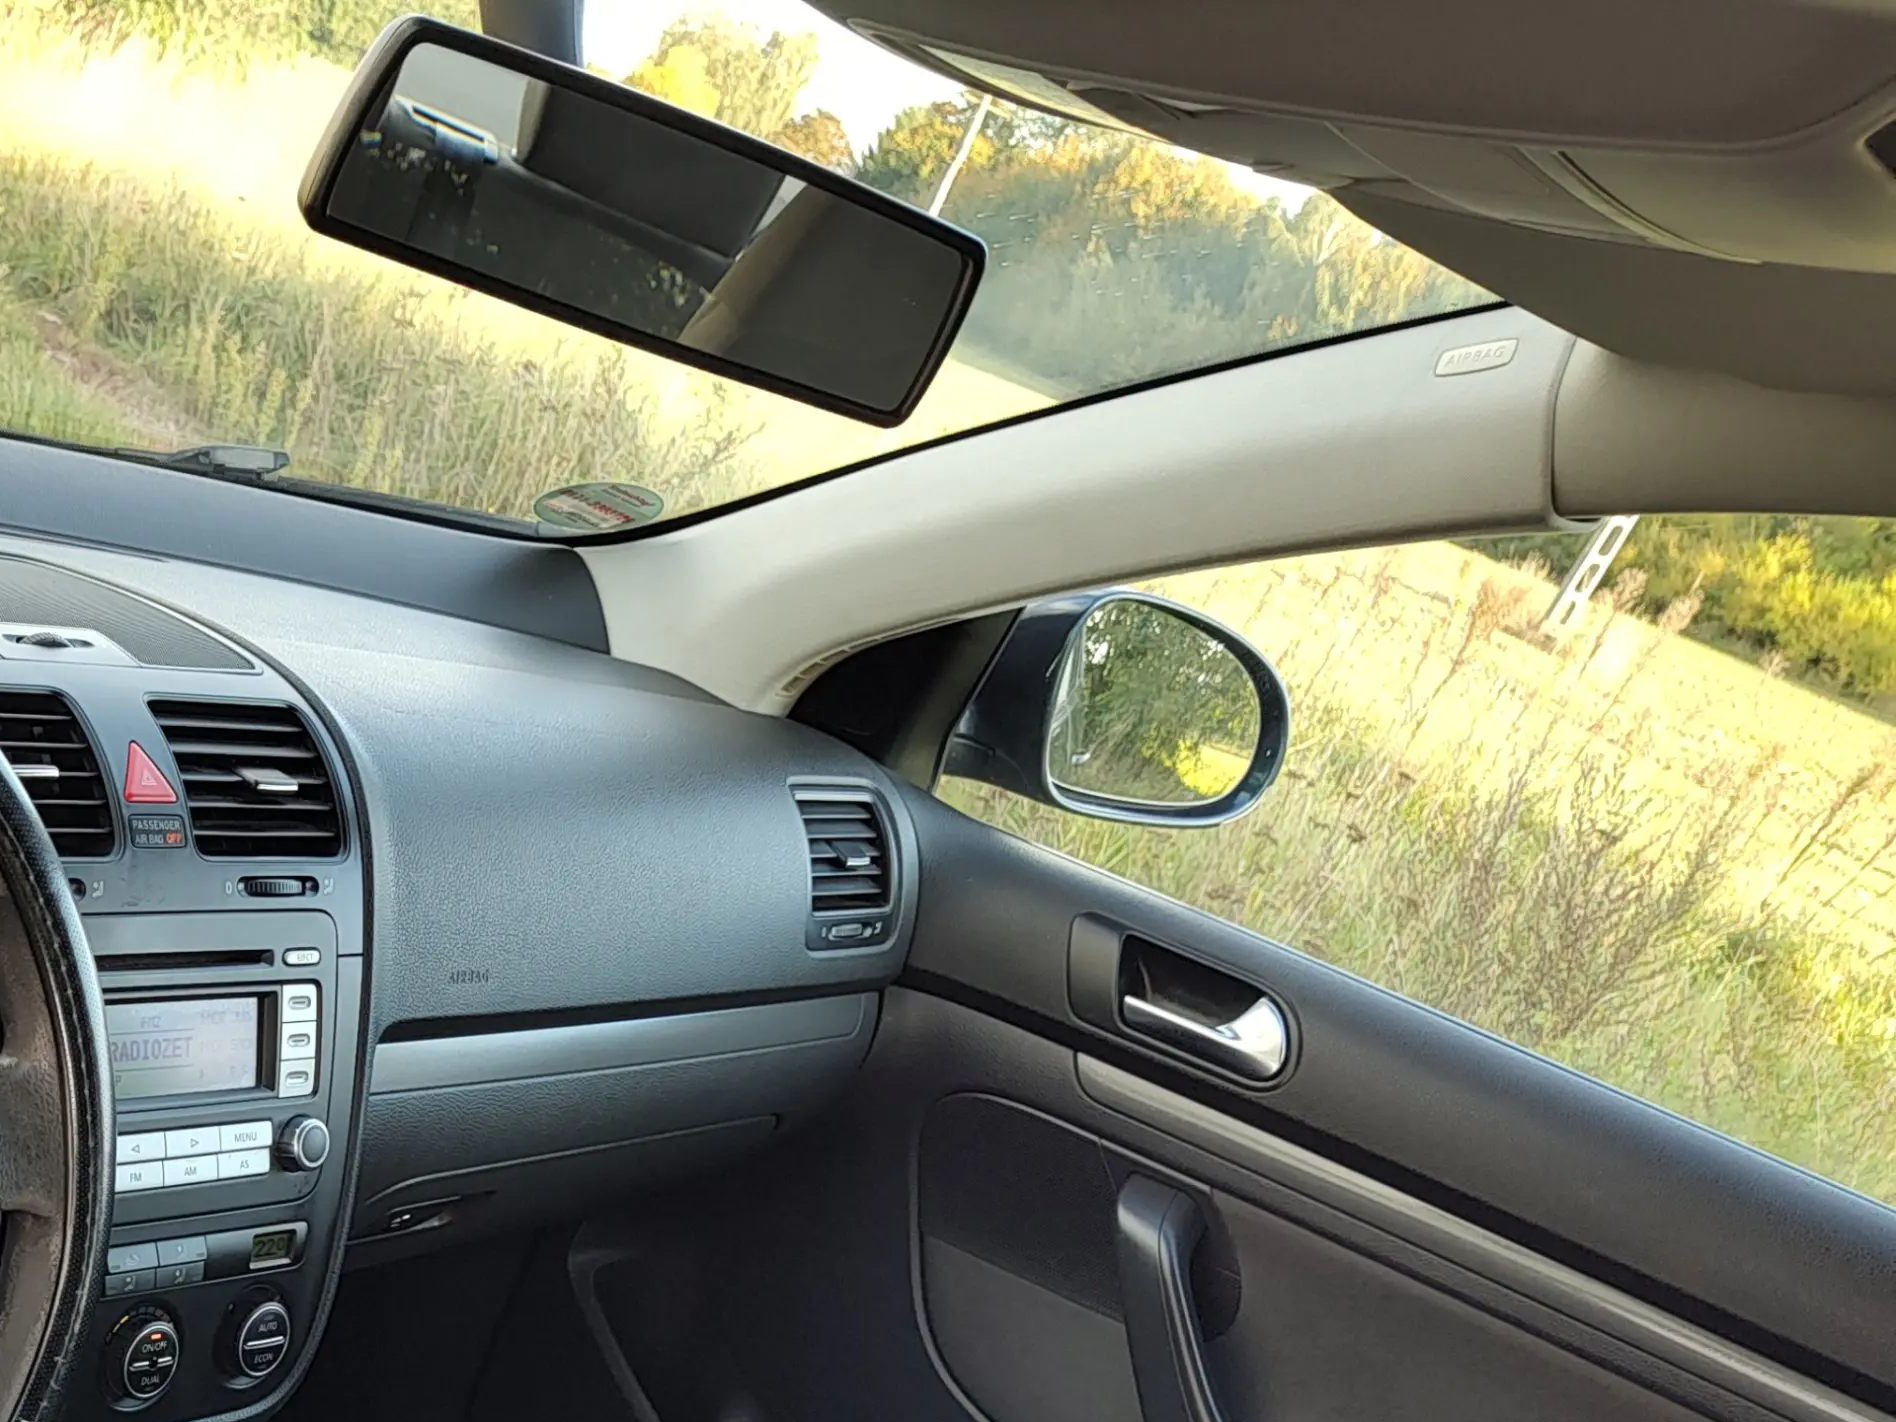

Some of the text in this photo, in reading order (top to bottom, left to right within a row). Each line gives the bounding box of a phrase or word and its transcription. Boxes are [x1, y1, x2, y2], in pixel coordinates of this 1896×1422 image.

[1444, 346, 1506, 368] AIRBAG
[132, 820, 181, 831] PASSENGER
[110, 1036, 194, 1063] RADIOZET
[234, 1133, 258, 1143] MENU
[240, 1159, 250, 1169] AS
[184, 1166, 198, 1177] AM
[129, 1172, 142, 1183] FM
[258, 1321, 278, 1332] AUTO
[141, 1374, 160, 1386] DUAL
